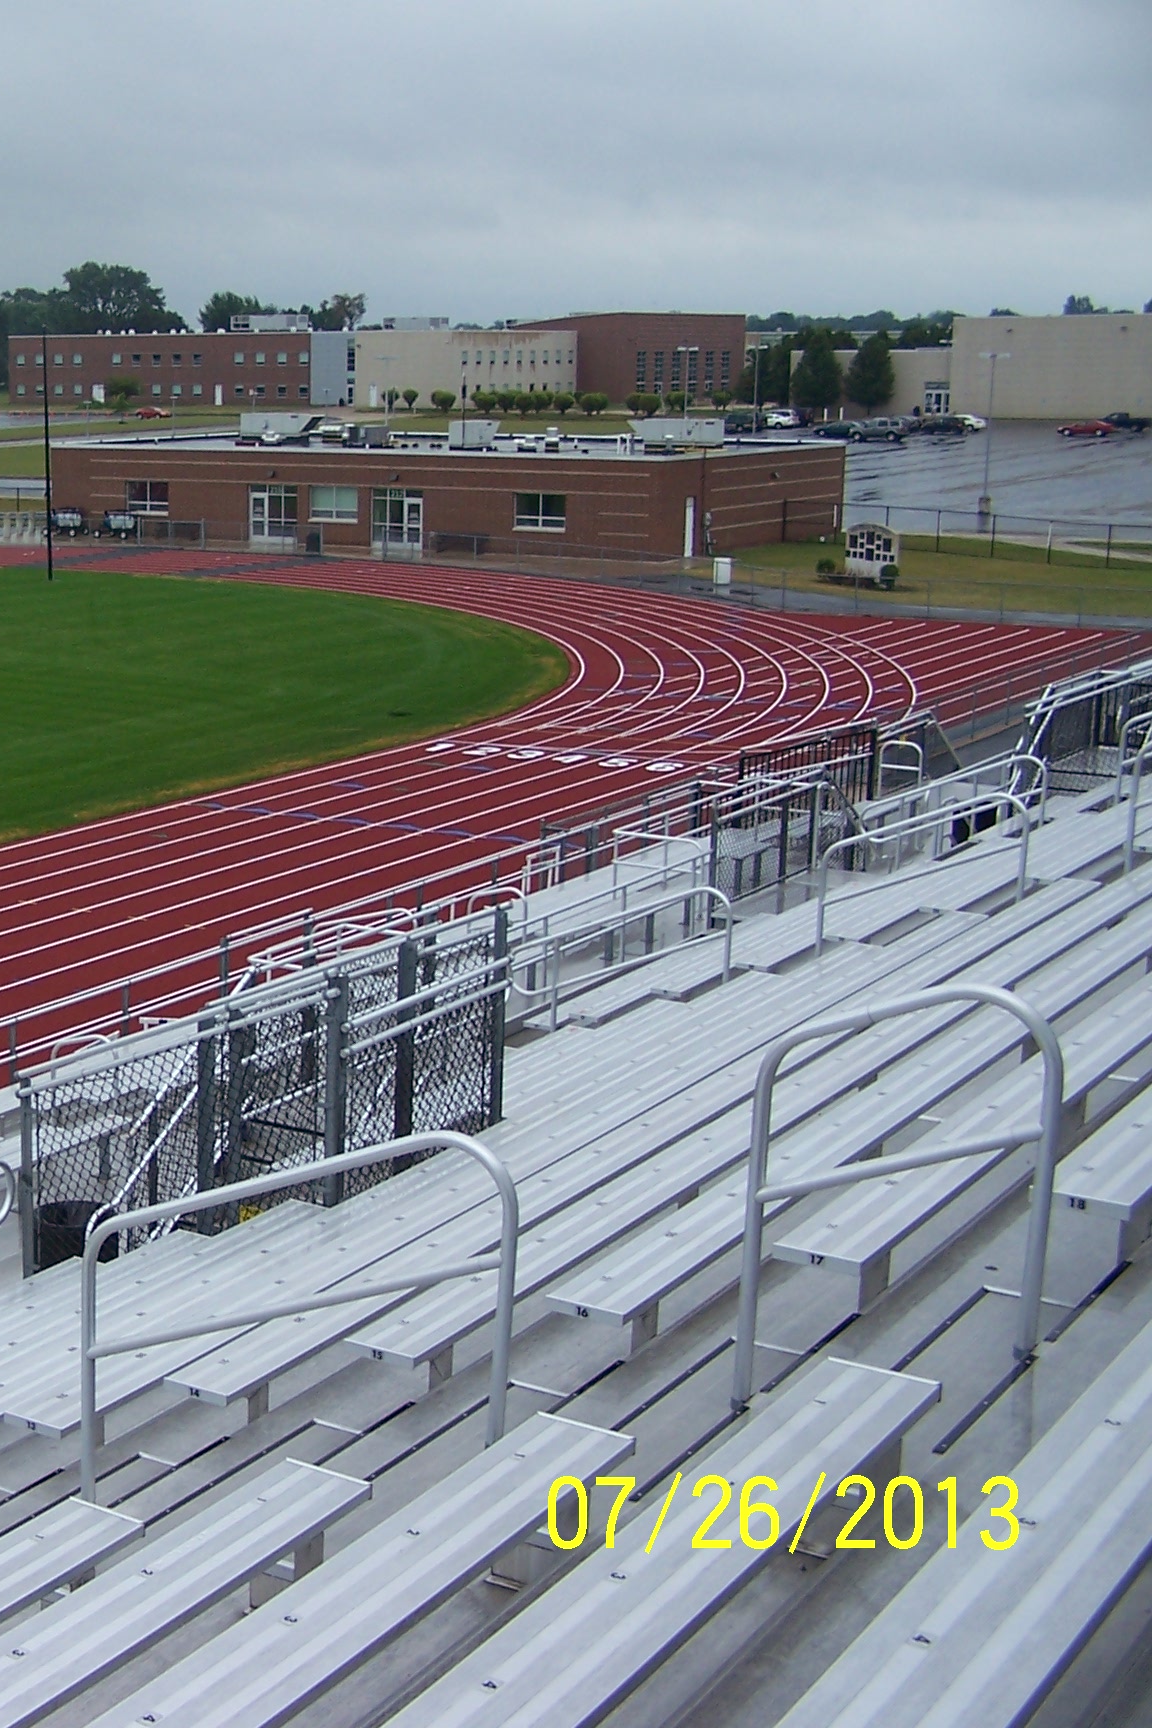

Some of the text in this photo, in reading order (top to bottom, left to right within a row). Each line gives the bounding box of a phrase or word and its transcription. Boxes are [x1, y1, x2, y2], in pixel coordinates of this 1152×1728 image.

[425, 742, 684, 773] 1 2 3 4 5 6
[1069, 1196, 1087, 1210] 18
[810, 1253, 825, 1266] 17
[575, 1305, 589, 1318] 16
[371, 1348, 384, 1361] 15
[912, 1633, 932, 1646] 4
[481, 1679, 498, 1690] 4
